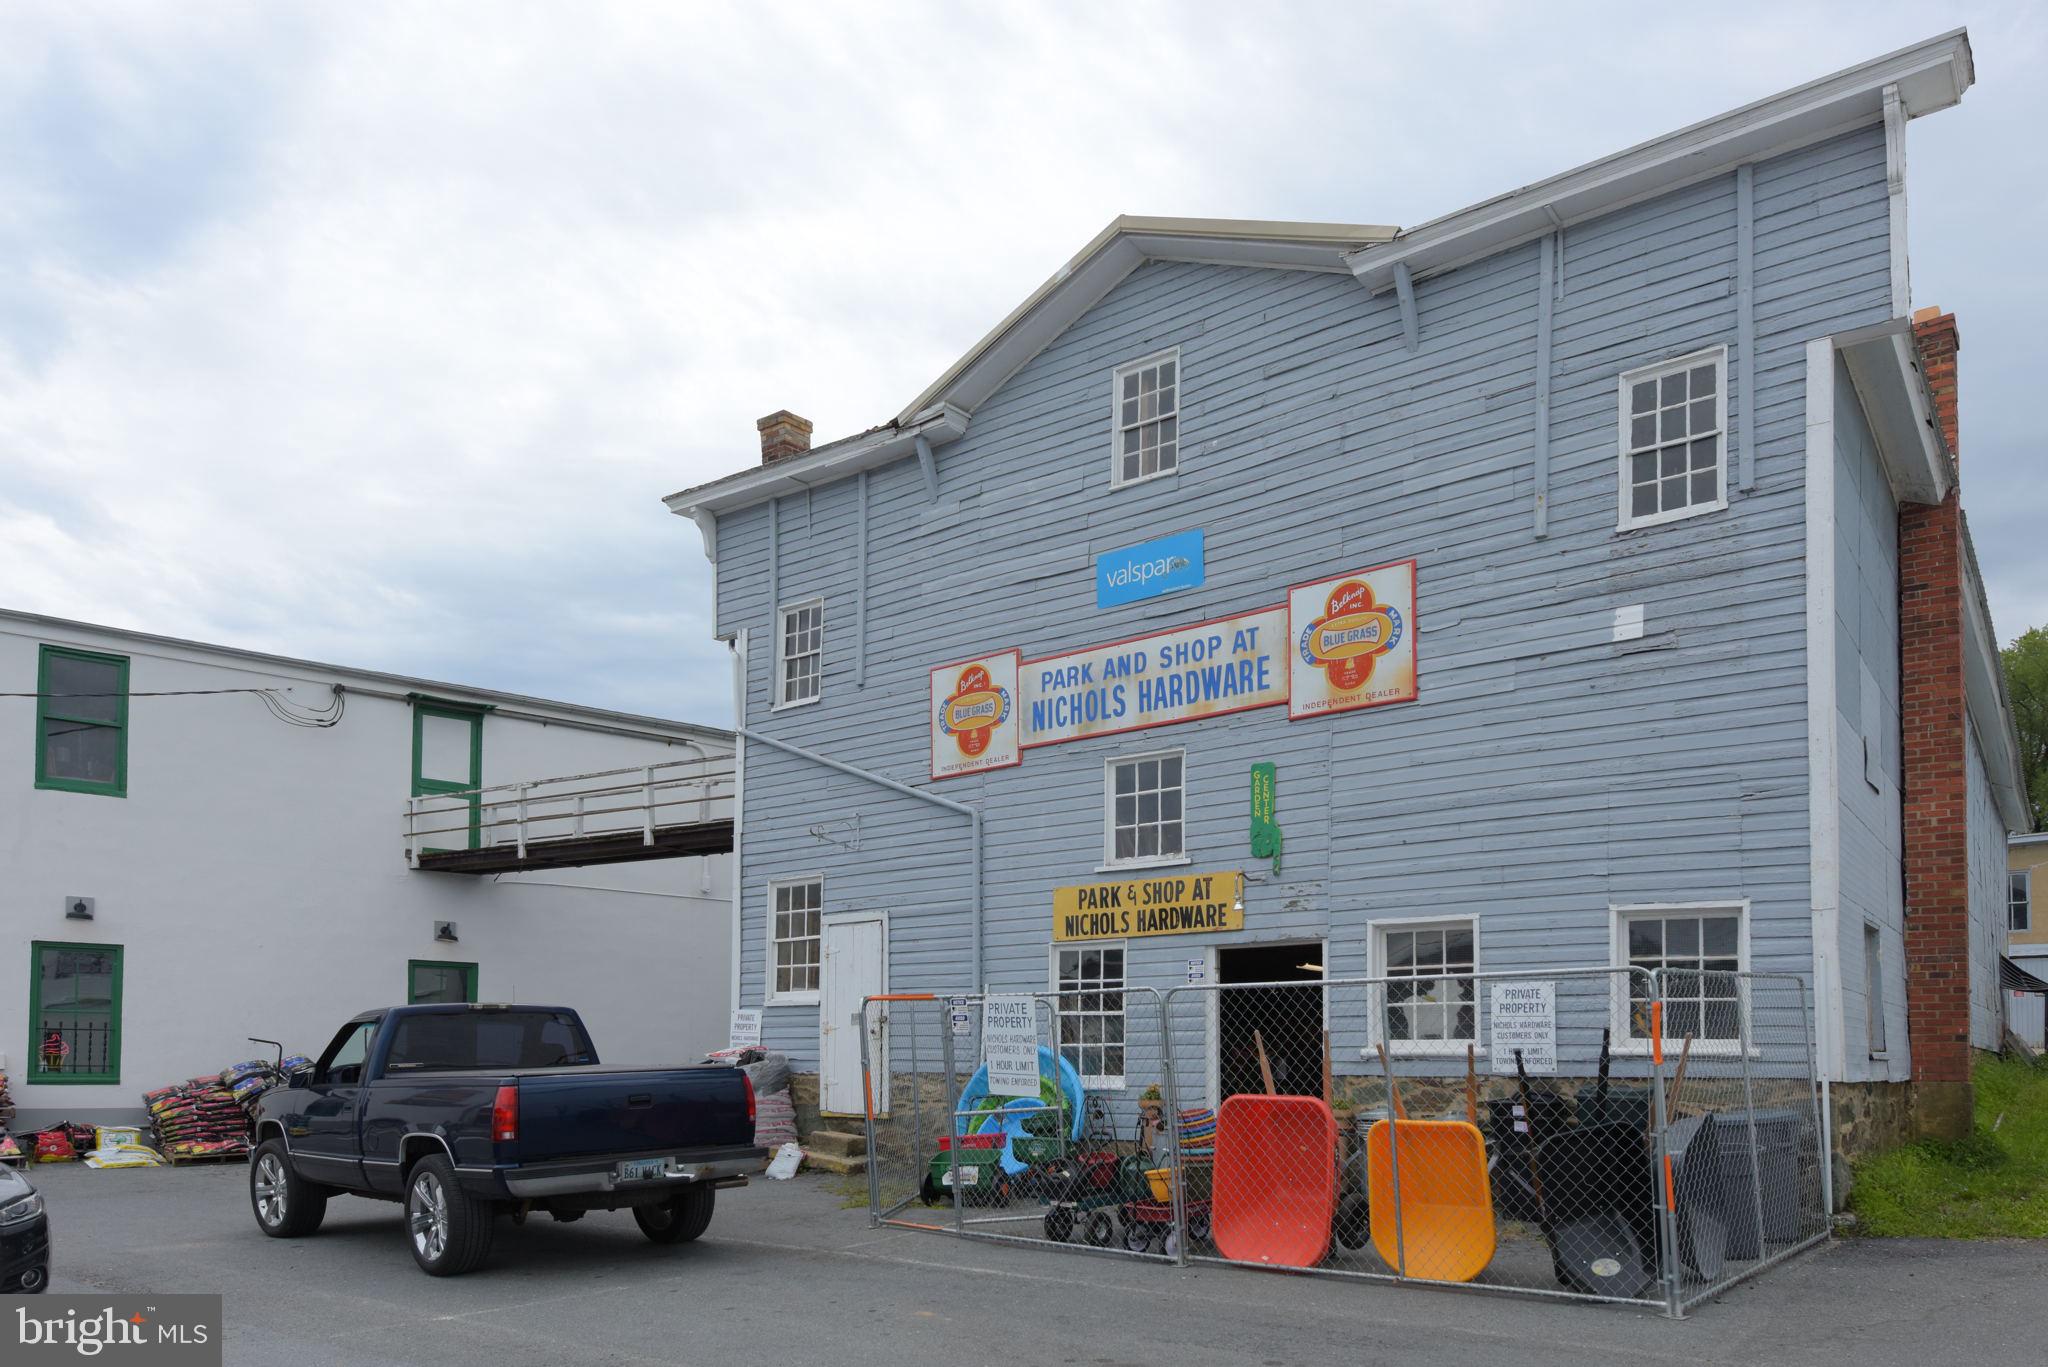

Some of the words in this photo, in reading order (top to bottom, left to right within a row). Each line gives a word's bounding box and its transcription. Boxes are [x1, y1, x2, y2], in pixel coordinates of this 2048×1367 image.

[1106, 556, 1176, 587] valspar
[1331, 587, 1365, 614] Belknap
[1323, 632, 1346, 647] BLUE
[1347, 625, 1378, 641] GRASS
[1388, 608, 1401, 647] MARK
[1301, 626, 1315, 662] TRADE
[1041, 662, 1093, 693] PARK
[1103, 651, 1147, 680] AND
[1159, 635, 1222, 669] SHOP
[1232, 626, 1260, 655] AT
[1032, 684, 1126, 732] NICHOLS
[1138, 655, 1271, 713] HARDWARE
[1302, 694, 1361, 711] INDEPENDENT
[1365, 687, 1401, 701] DEALER
[955, 707, 971, 720] BLUE
[971, 702, 994, 716] GRASS
[985, 754, 1010, 765] DEALER
[1253, 770, 1261, 817] GARDEN
[1078, 885, 1122, 910] PARK
[1127, 884, 1137, 906] &
[1142, 879, 1185, 906] SHOP
[1192, 877, 1213, 901] AT
[1065, 911, 1130, 937] NICHOLS
[1136, 903, 1227, 932] HARDWARE
[1505, 988, 1541, 1000] PRIVATE
[988, 1002, 1028, 1014] PRIVATE
[1499, 1002, 1547, 1013] PROPERTY
[987, 1015, 1033, 1028] PROPERTY
[1497, 1031, 1532, 1039] CUSTOMERS
[1534, 1031, 1549, 1039] ONLY
[986, 1045, 1020, 1055] CUSTOMERS
[996, 1061, 1013, 1071] HOUR
[1015, 1061, 1034, 1071] LIMIT
